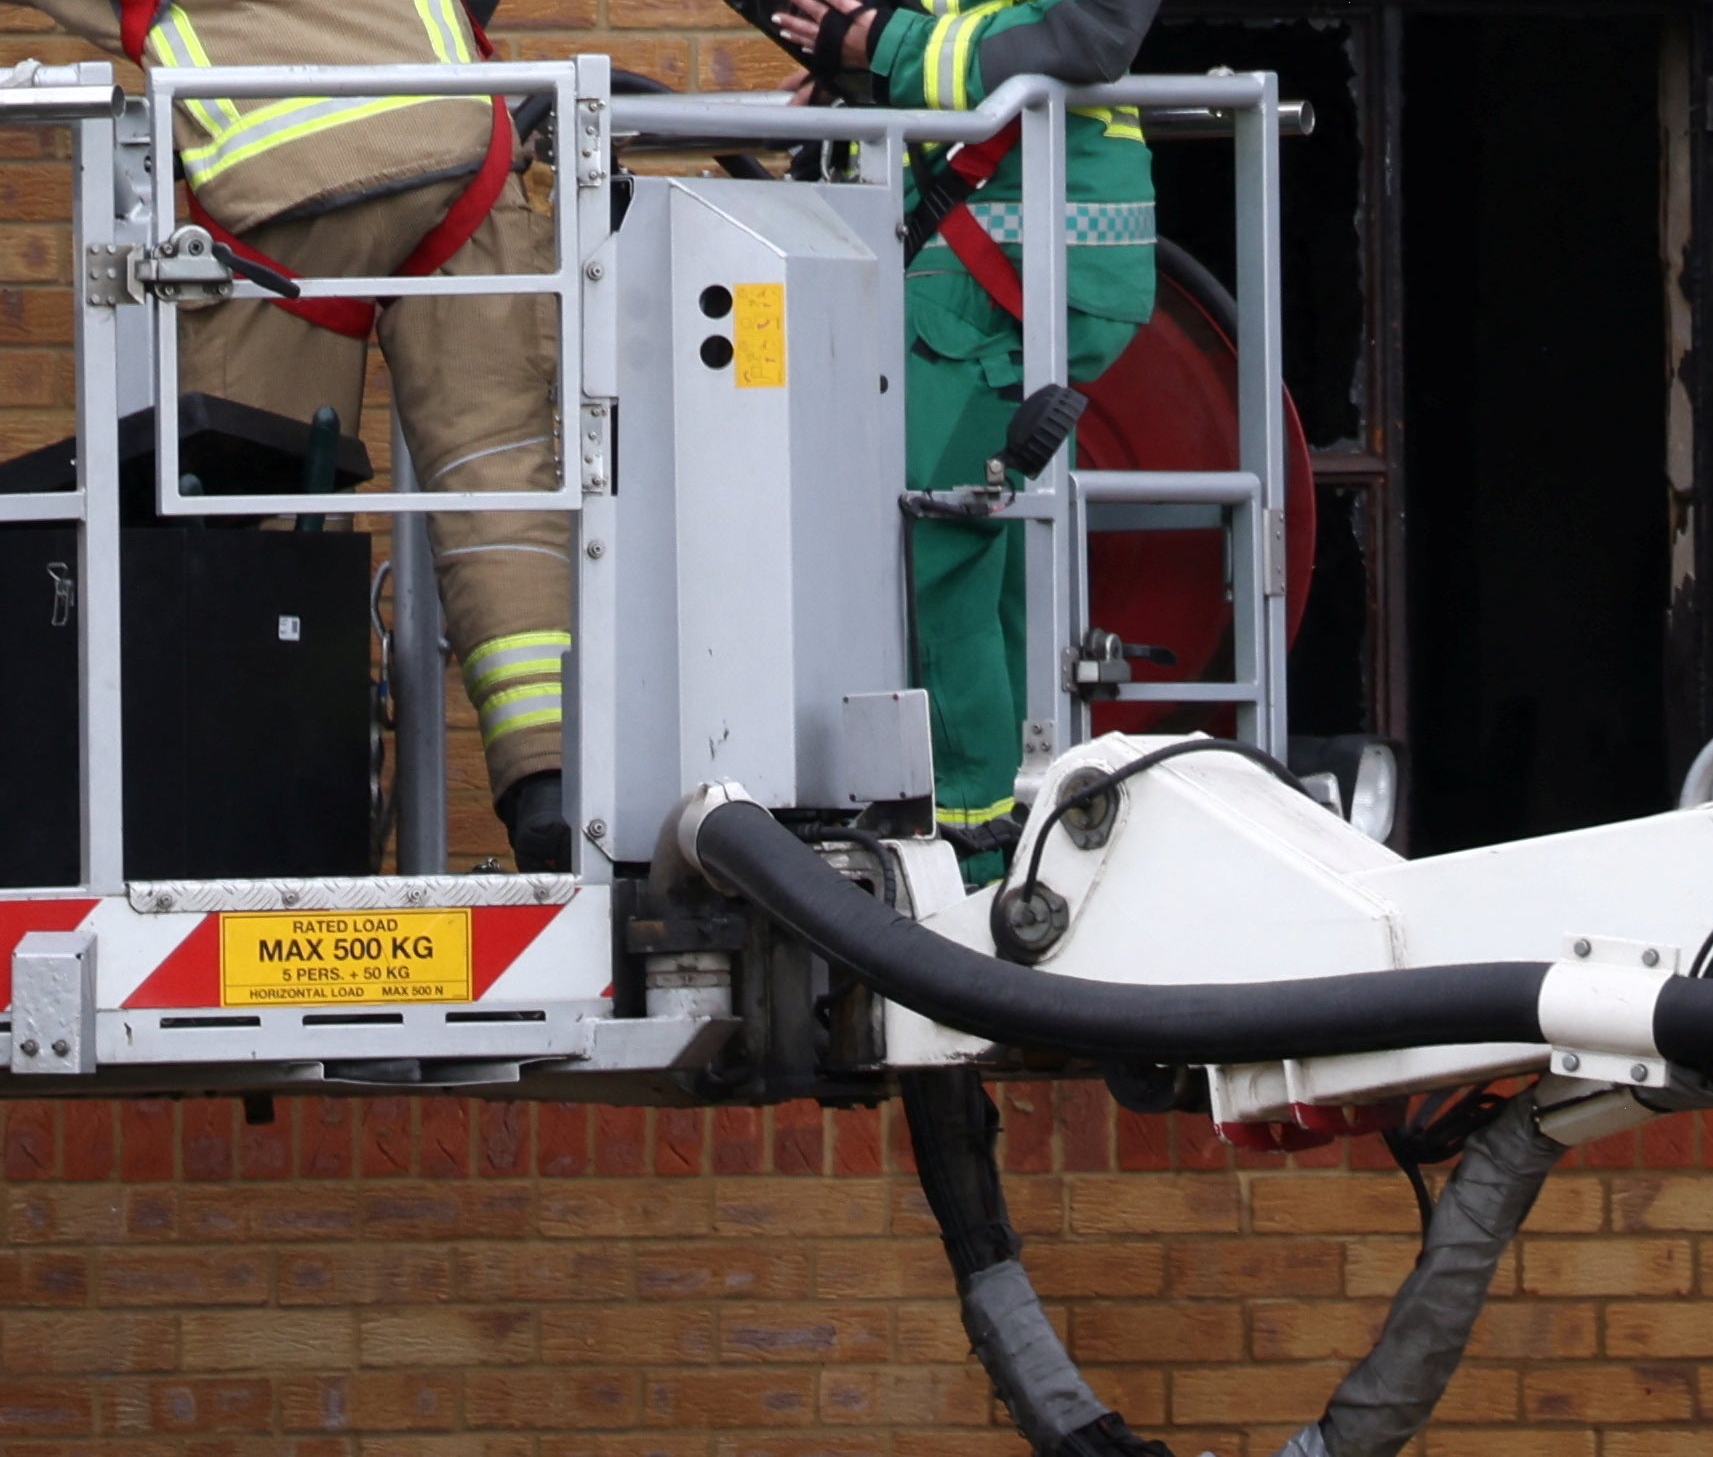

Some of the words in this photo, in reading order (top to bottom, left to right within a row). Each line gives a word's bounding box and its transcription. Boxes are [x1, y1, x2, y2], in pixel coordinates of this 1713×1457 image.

[293, 919, 348, 934] RATED
[353, 918, 399, 933] LOAD
[259, 938, 324, 962] MAX
[333, 937, 382, 961] 500
[392, 936, 433, 960] KG
[282, 968, 292, 982] 5
[296, 967, 345, 981] PERS.
[349, 970, 359, 980] +
[363, 966, 382, 980] 50
[386, 965, 410, 980] KG
[249, 987, 328, 999] HORIZONTAL
[331, 986, 365, 998] LOAD
[381, 986, 408, 997] MAX
[411, 985, 433, 996] 500
[435, 985, 444, 996] N
